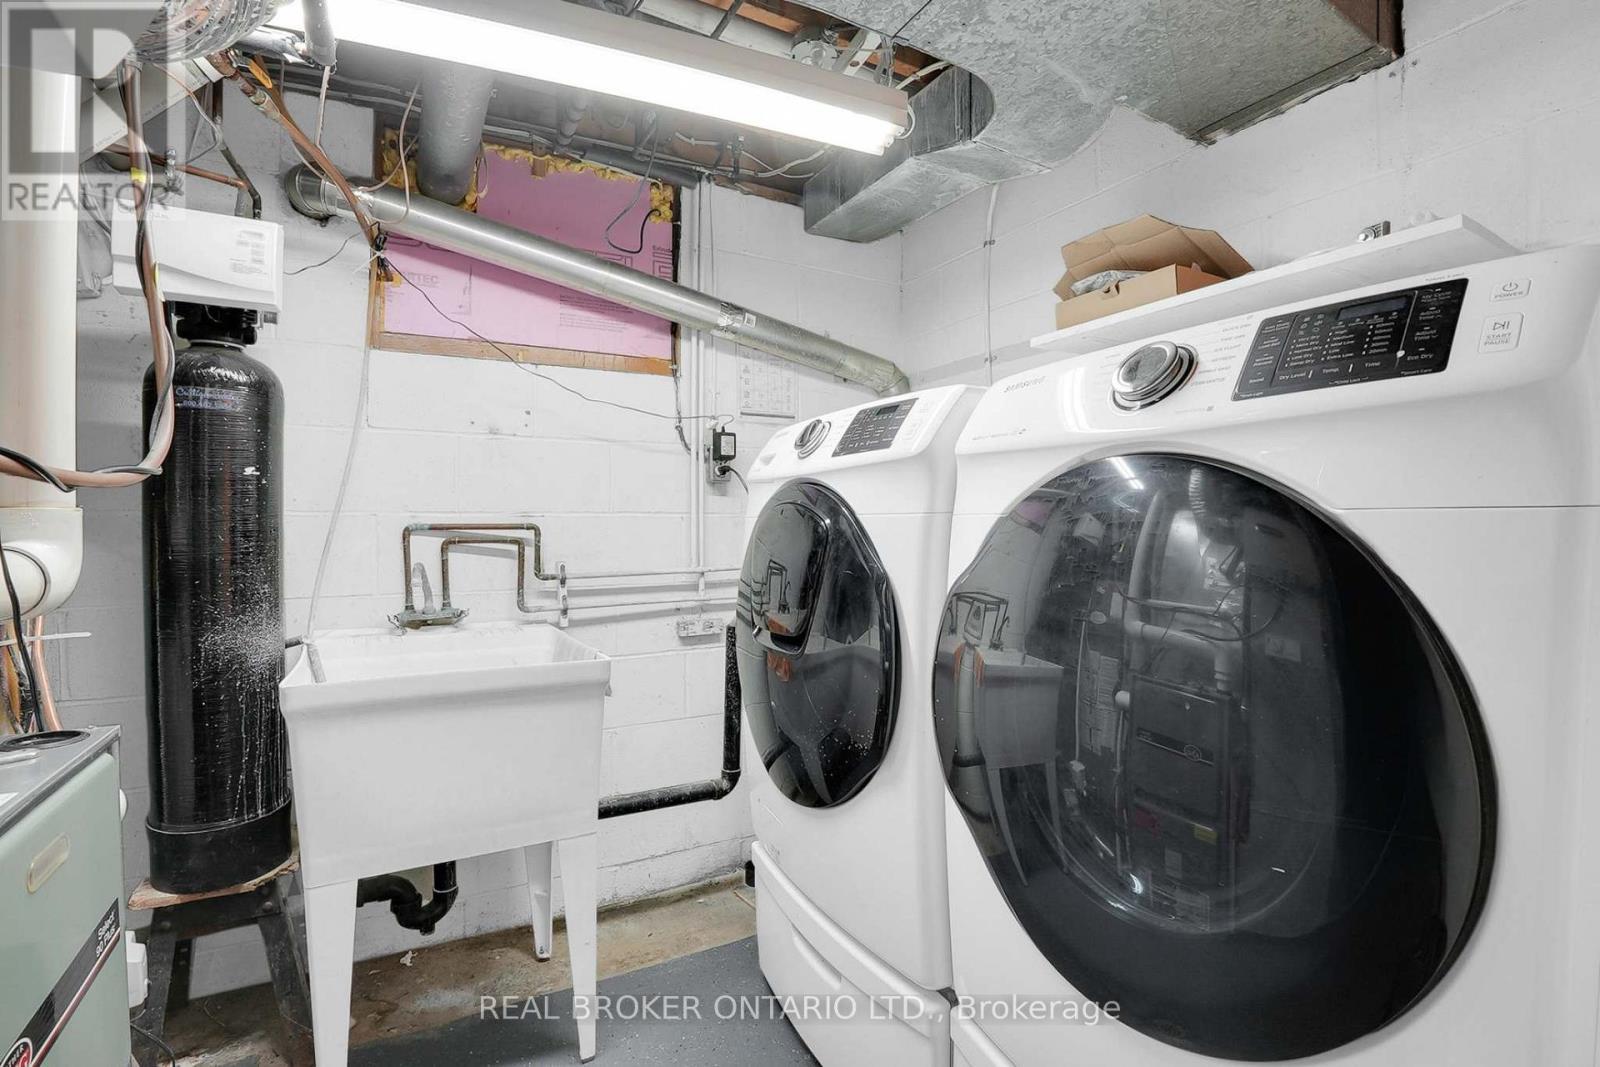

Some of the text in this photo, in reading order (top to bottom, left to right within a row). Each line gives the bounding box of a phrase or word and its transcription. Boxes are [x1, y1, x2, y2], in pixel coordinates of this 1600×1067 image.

[1494, 291, 1523, 299] POWER
[1486, 332, 1512, 340] START
[1484, 338, 1509, 346] PAUSE
